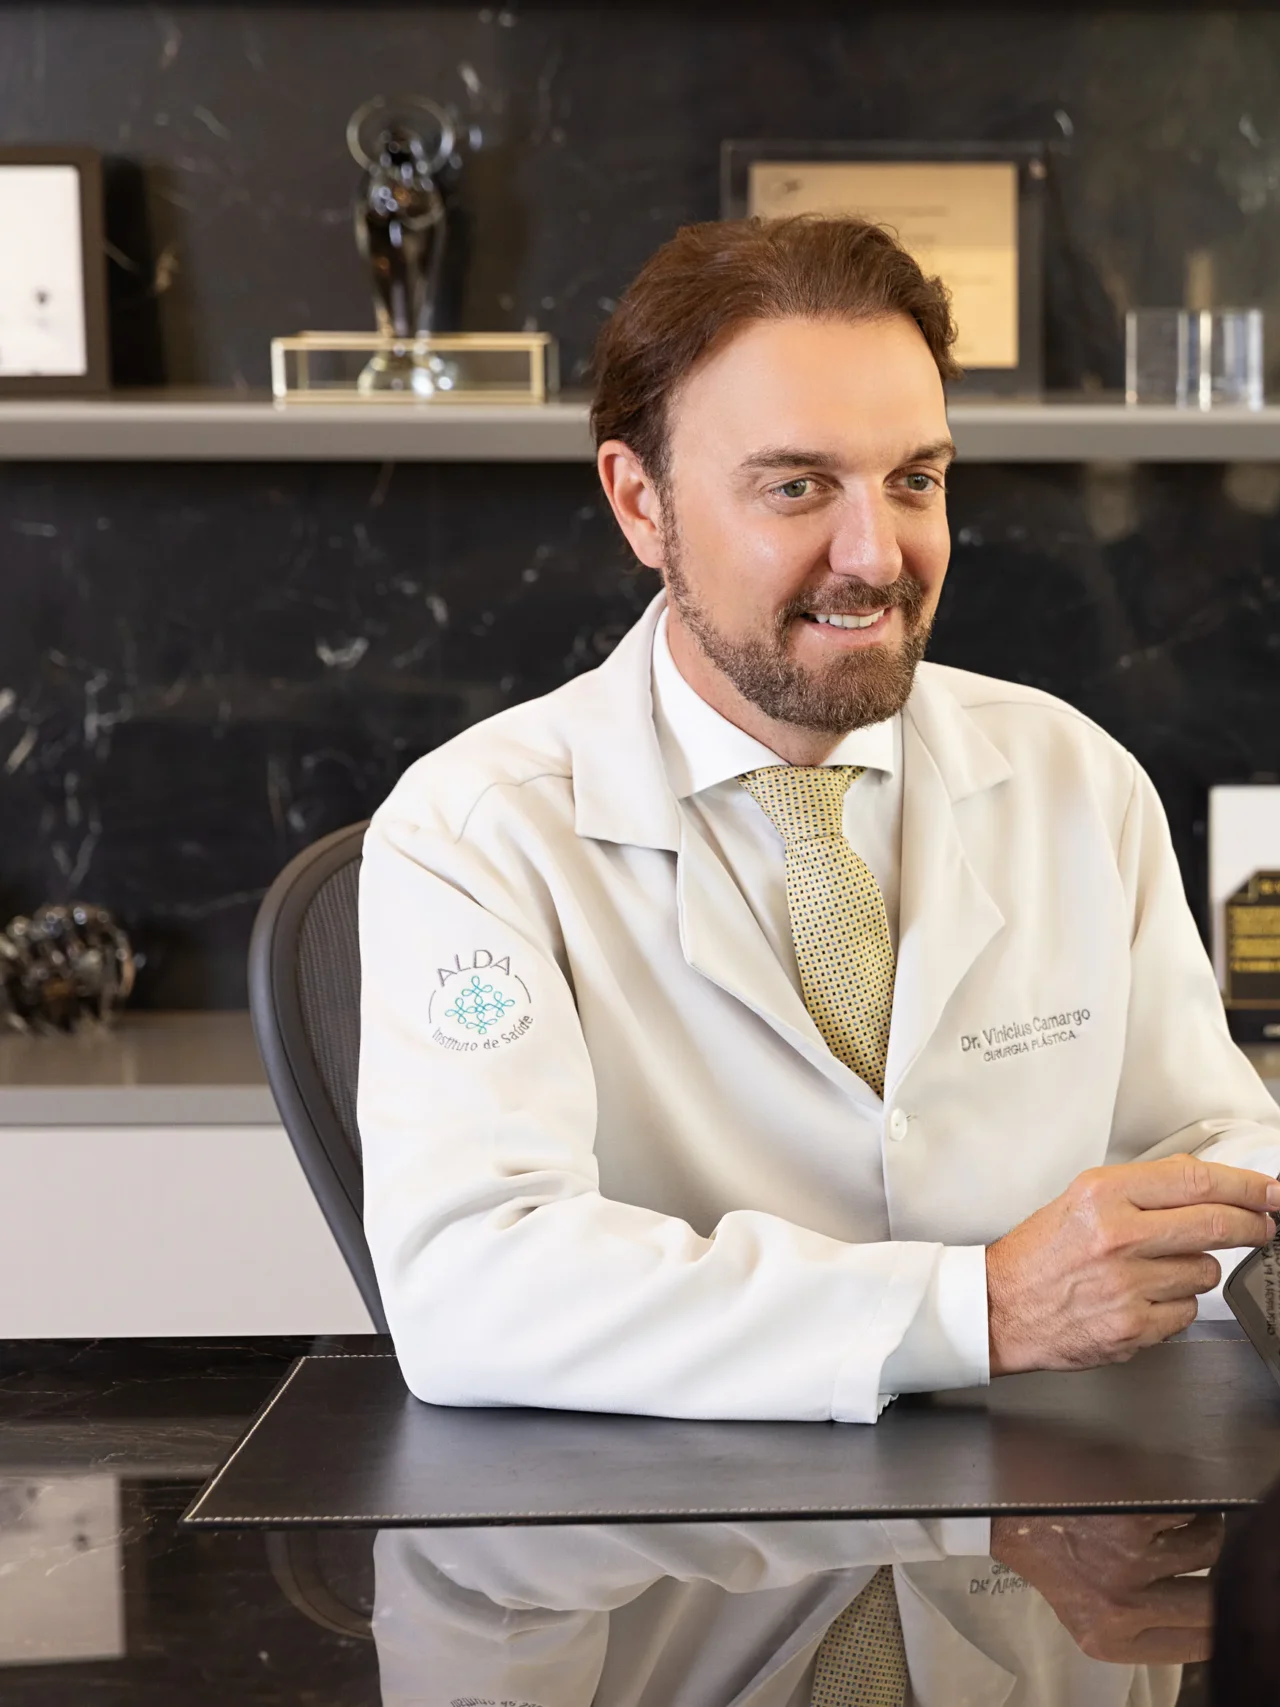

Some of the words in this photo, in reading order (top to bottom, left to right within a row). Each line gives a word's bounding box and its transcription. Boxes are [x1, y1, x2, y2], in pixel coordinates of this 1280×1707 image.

[437, 949, 511, 988] ALDA
[432, 1027, 478, 1052] Instituto
[483, 1038, 501, 1050] de
[501, 1015, 534, 1044] Saúde
[960, 1035, 981, 1052] Dr.
[1032, 1008, 1091, 1033] Camargo
[983, 1041, 1030, 1062] CIRURGIA
[1031, 1030, 1077, 1051] PLÁSTICA
